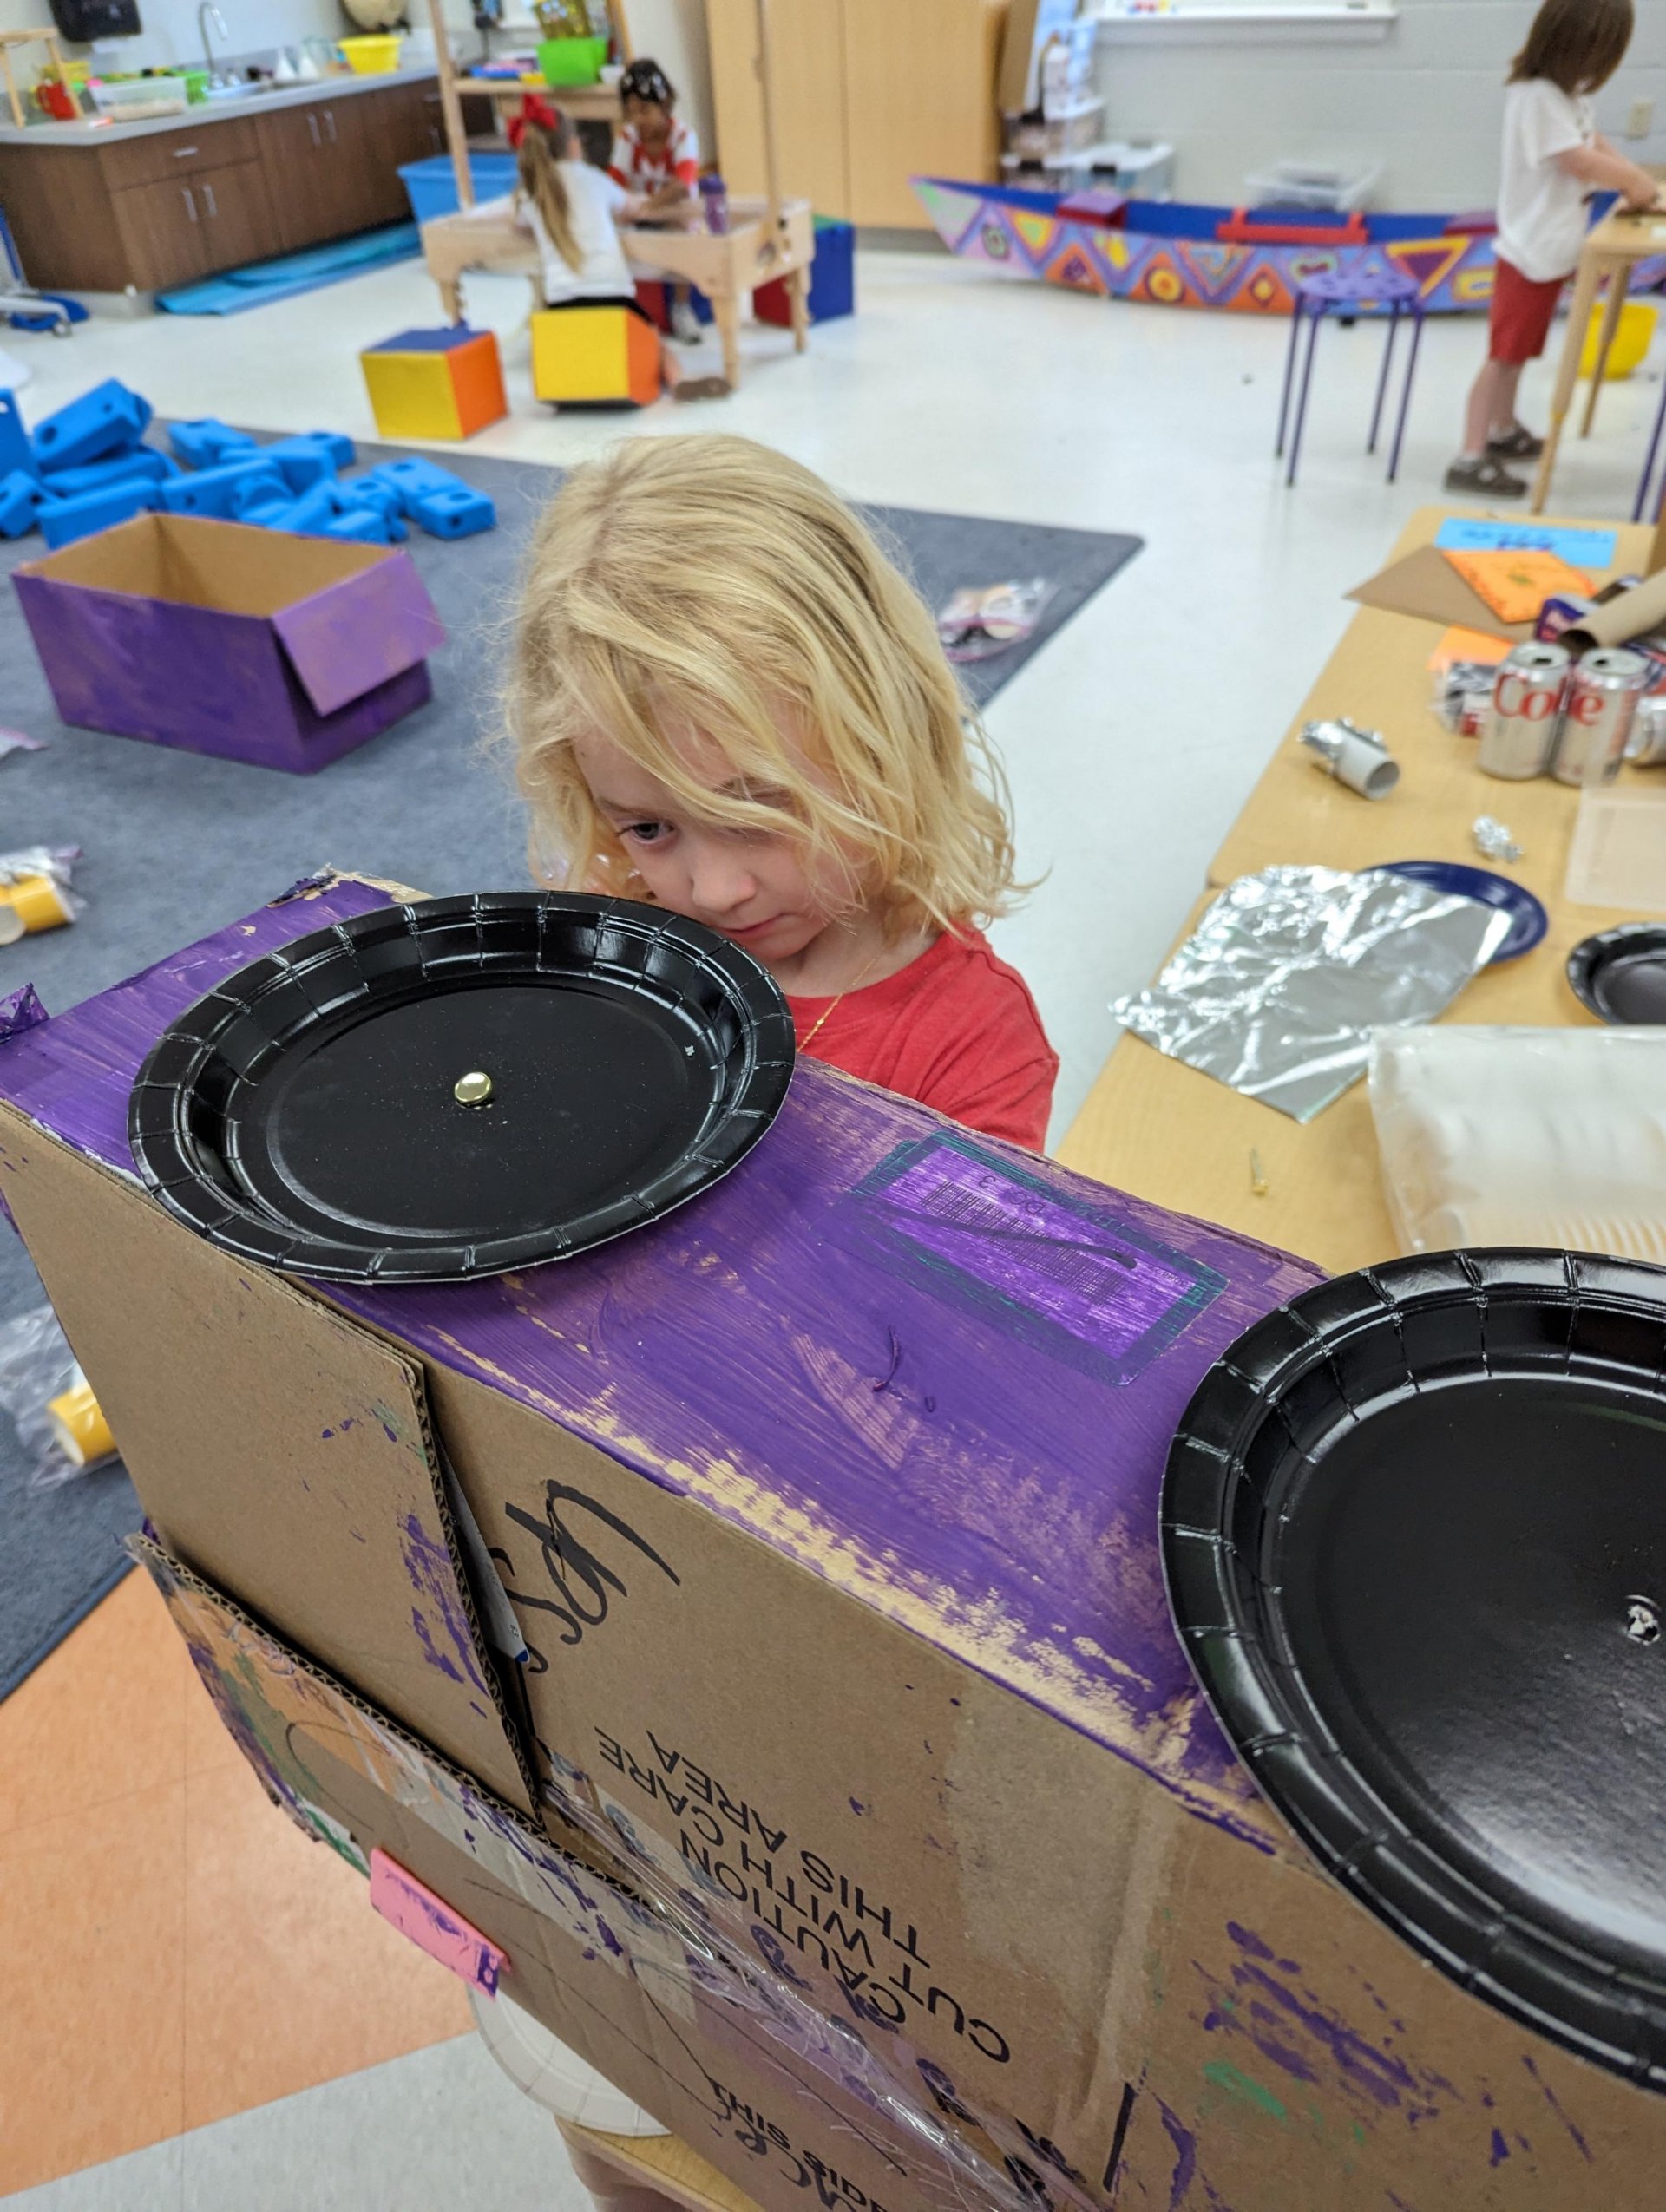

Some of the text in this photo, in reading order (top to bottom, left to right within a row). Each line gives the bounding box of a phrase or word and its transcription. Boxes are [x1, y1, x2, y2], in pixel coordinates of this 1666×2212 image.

[979, 1175, 996, 1188] 3
[594, 1725, 1010, 2064] CUT WITH CARE
[646, 1729, 931, 1969] THIS AREA
[680, 1829, 906, 2024] CAUTION
[707, 2076, 791, 2150] THIS
